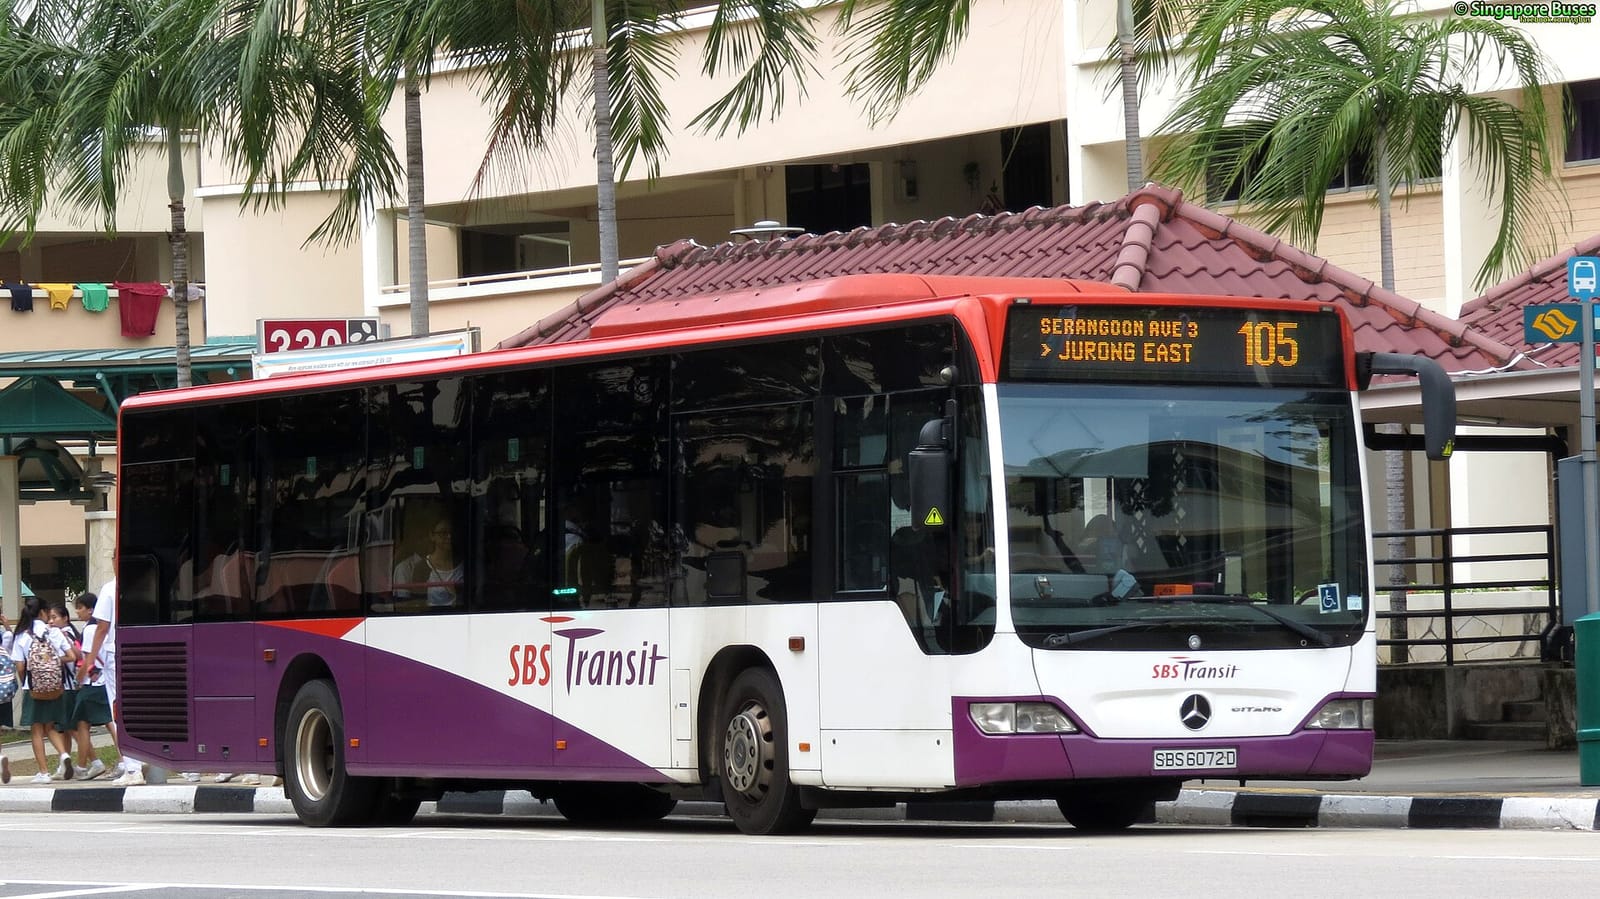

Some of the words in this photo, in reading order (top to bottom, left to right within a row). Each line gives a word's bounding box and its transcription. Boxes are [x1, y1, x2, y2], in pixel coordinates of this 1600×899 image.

[1041, 318, 1144, 336] SERANGOON
[1150, 321, 1182, 337] AVE
[1188, 322, 1198, 337] 3
[1058, 341, 1136, 362] JURONG
[1143, 344, 1193, 363] EAST
[1238, 321, 1298, 367] 105
[508, 644, 551, 686] SBS
[552, 628, 668, 695] Transit
[1152, 664, 1179, 679] SBS
[1177, 660, 1241, 681] Transit
